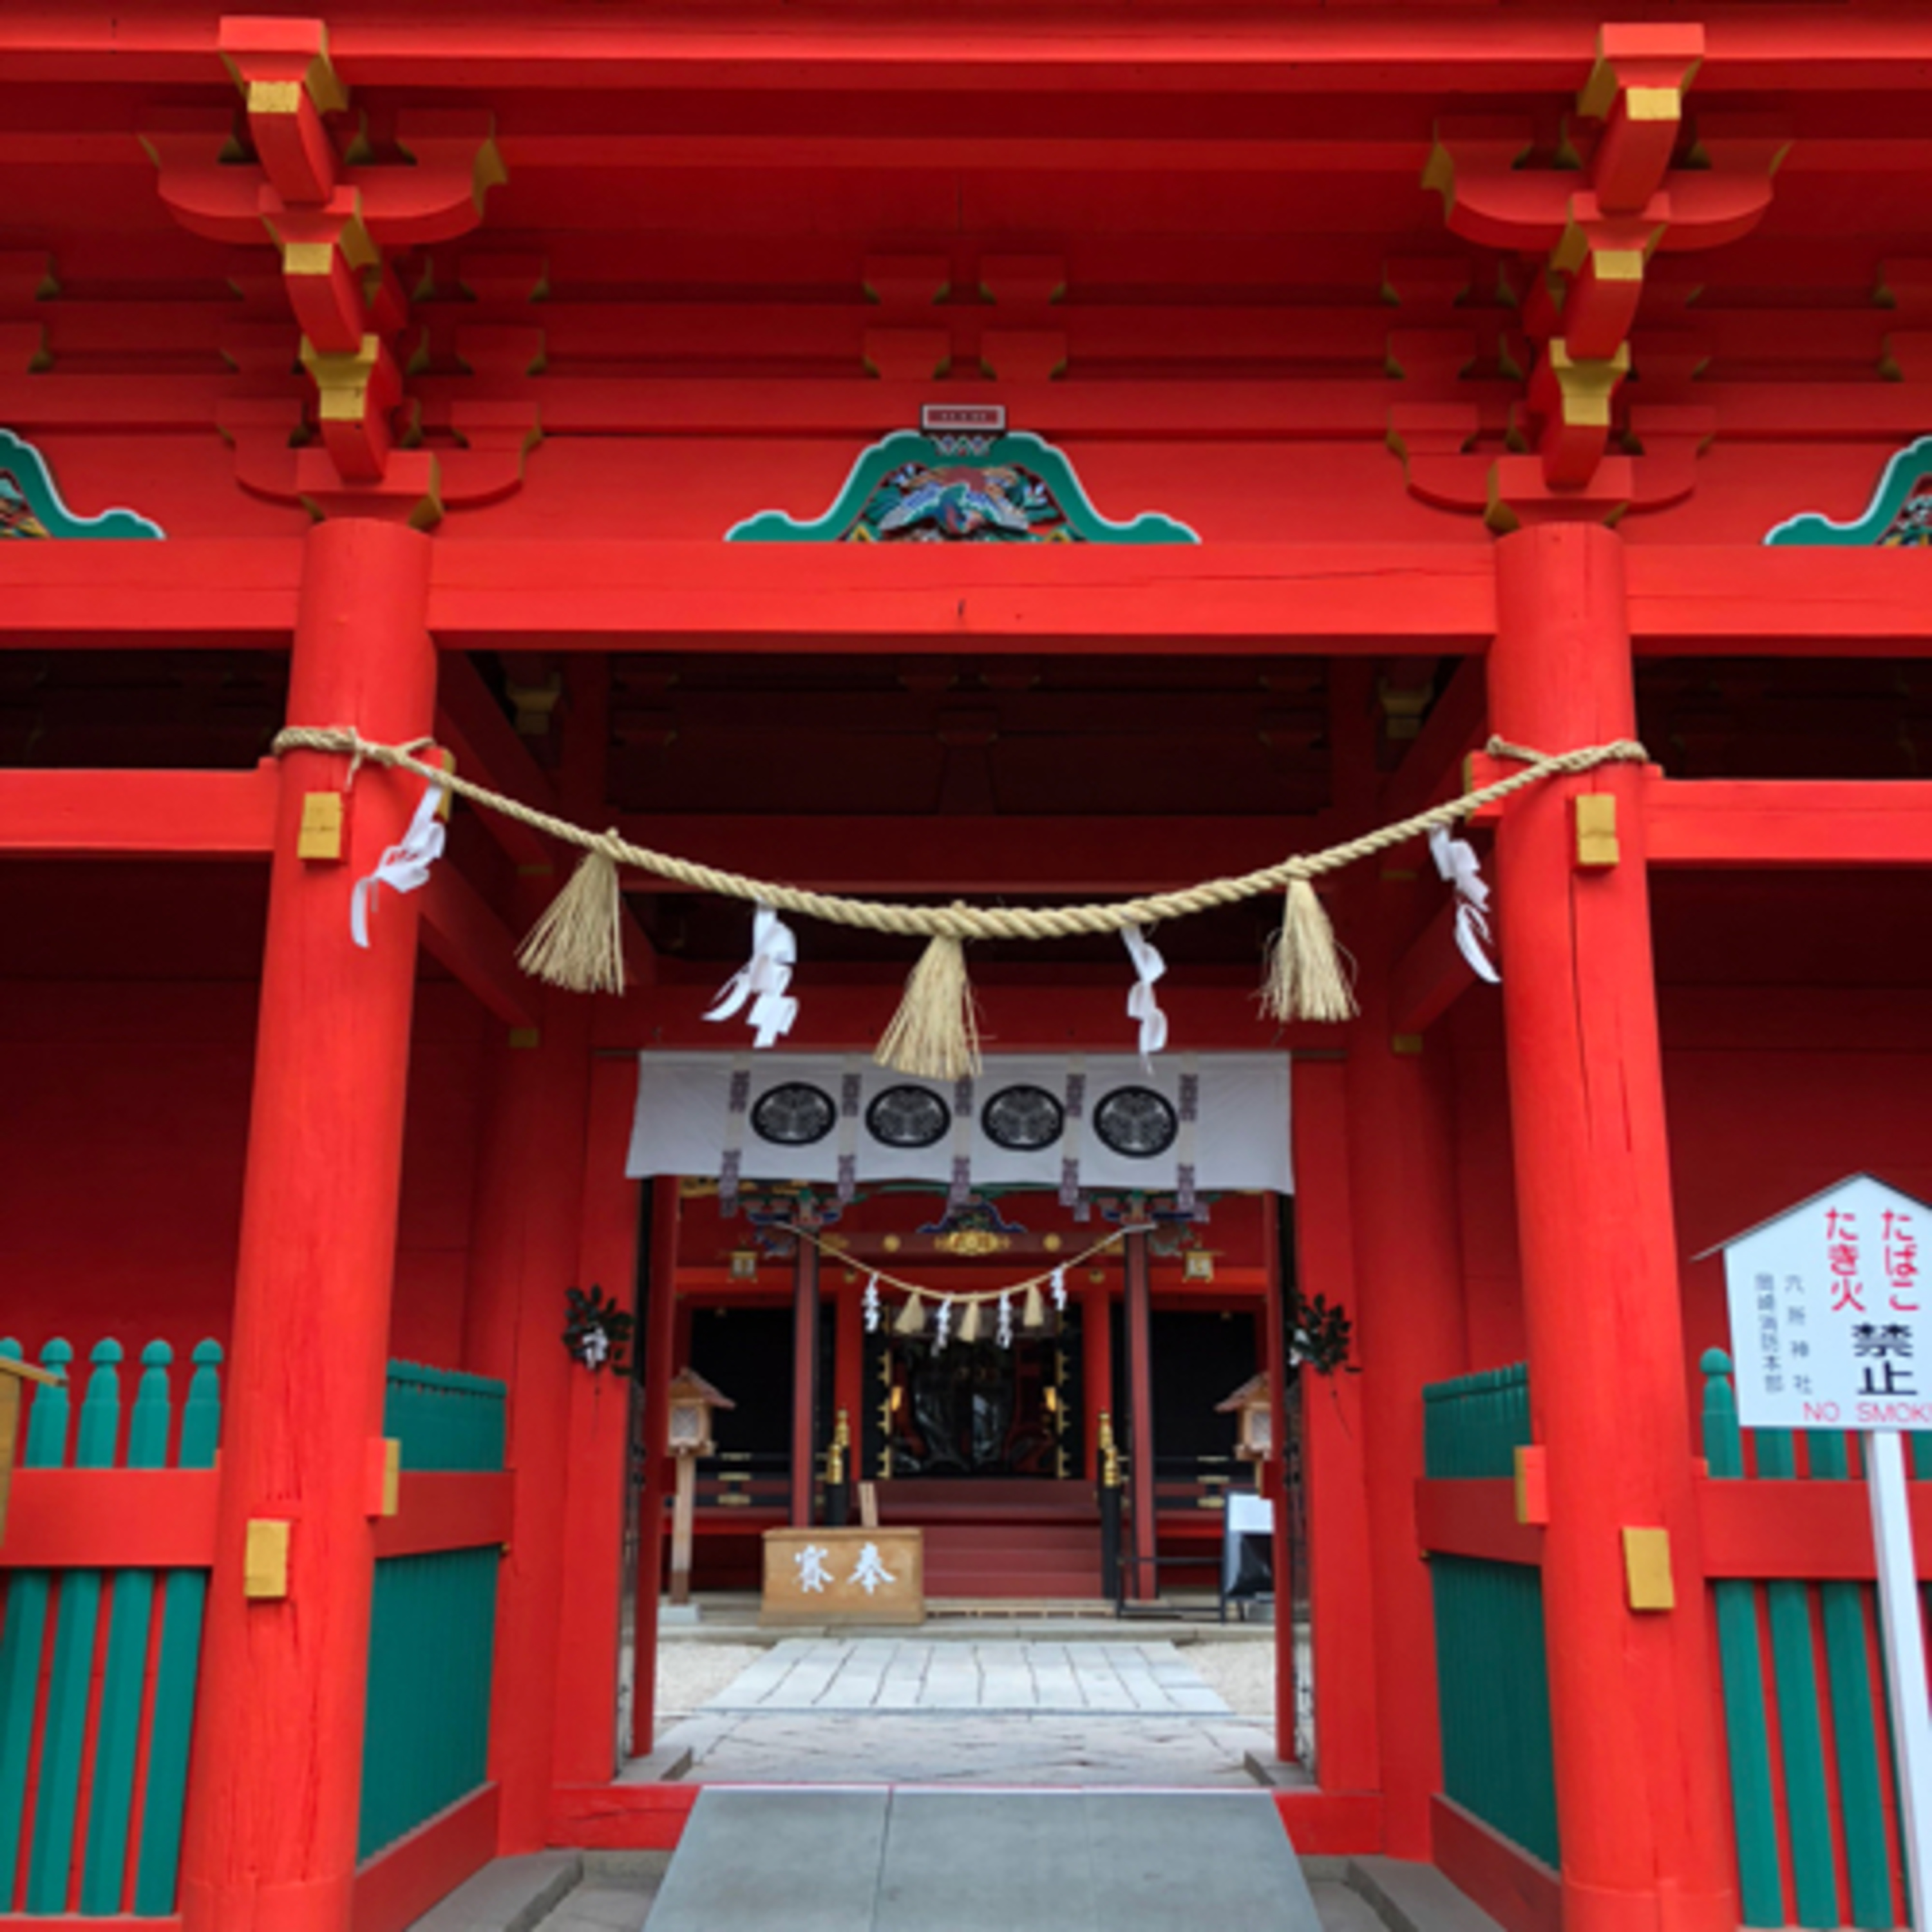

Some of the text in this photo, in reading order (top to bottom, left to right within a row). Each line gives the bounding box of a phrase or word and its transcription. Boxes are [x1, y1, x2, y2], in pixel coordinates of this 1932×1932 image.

[1824, 1206, 1866, 1312] たき火
[1880, 1206, 1920, 1311] たばこ
[1851, 1323, 1918, 1396] 禁止
[1803, 1401, 1840, 1423] NO
